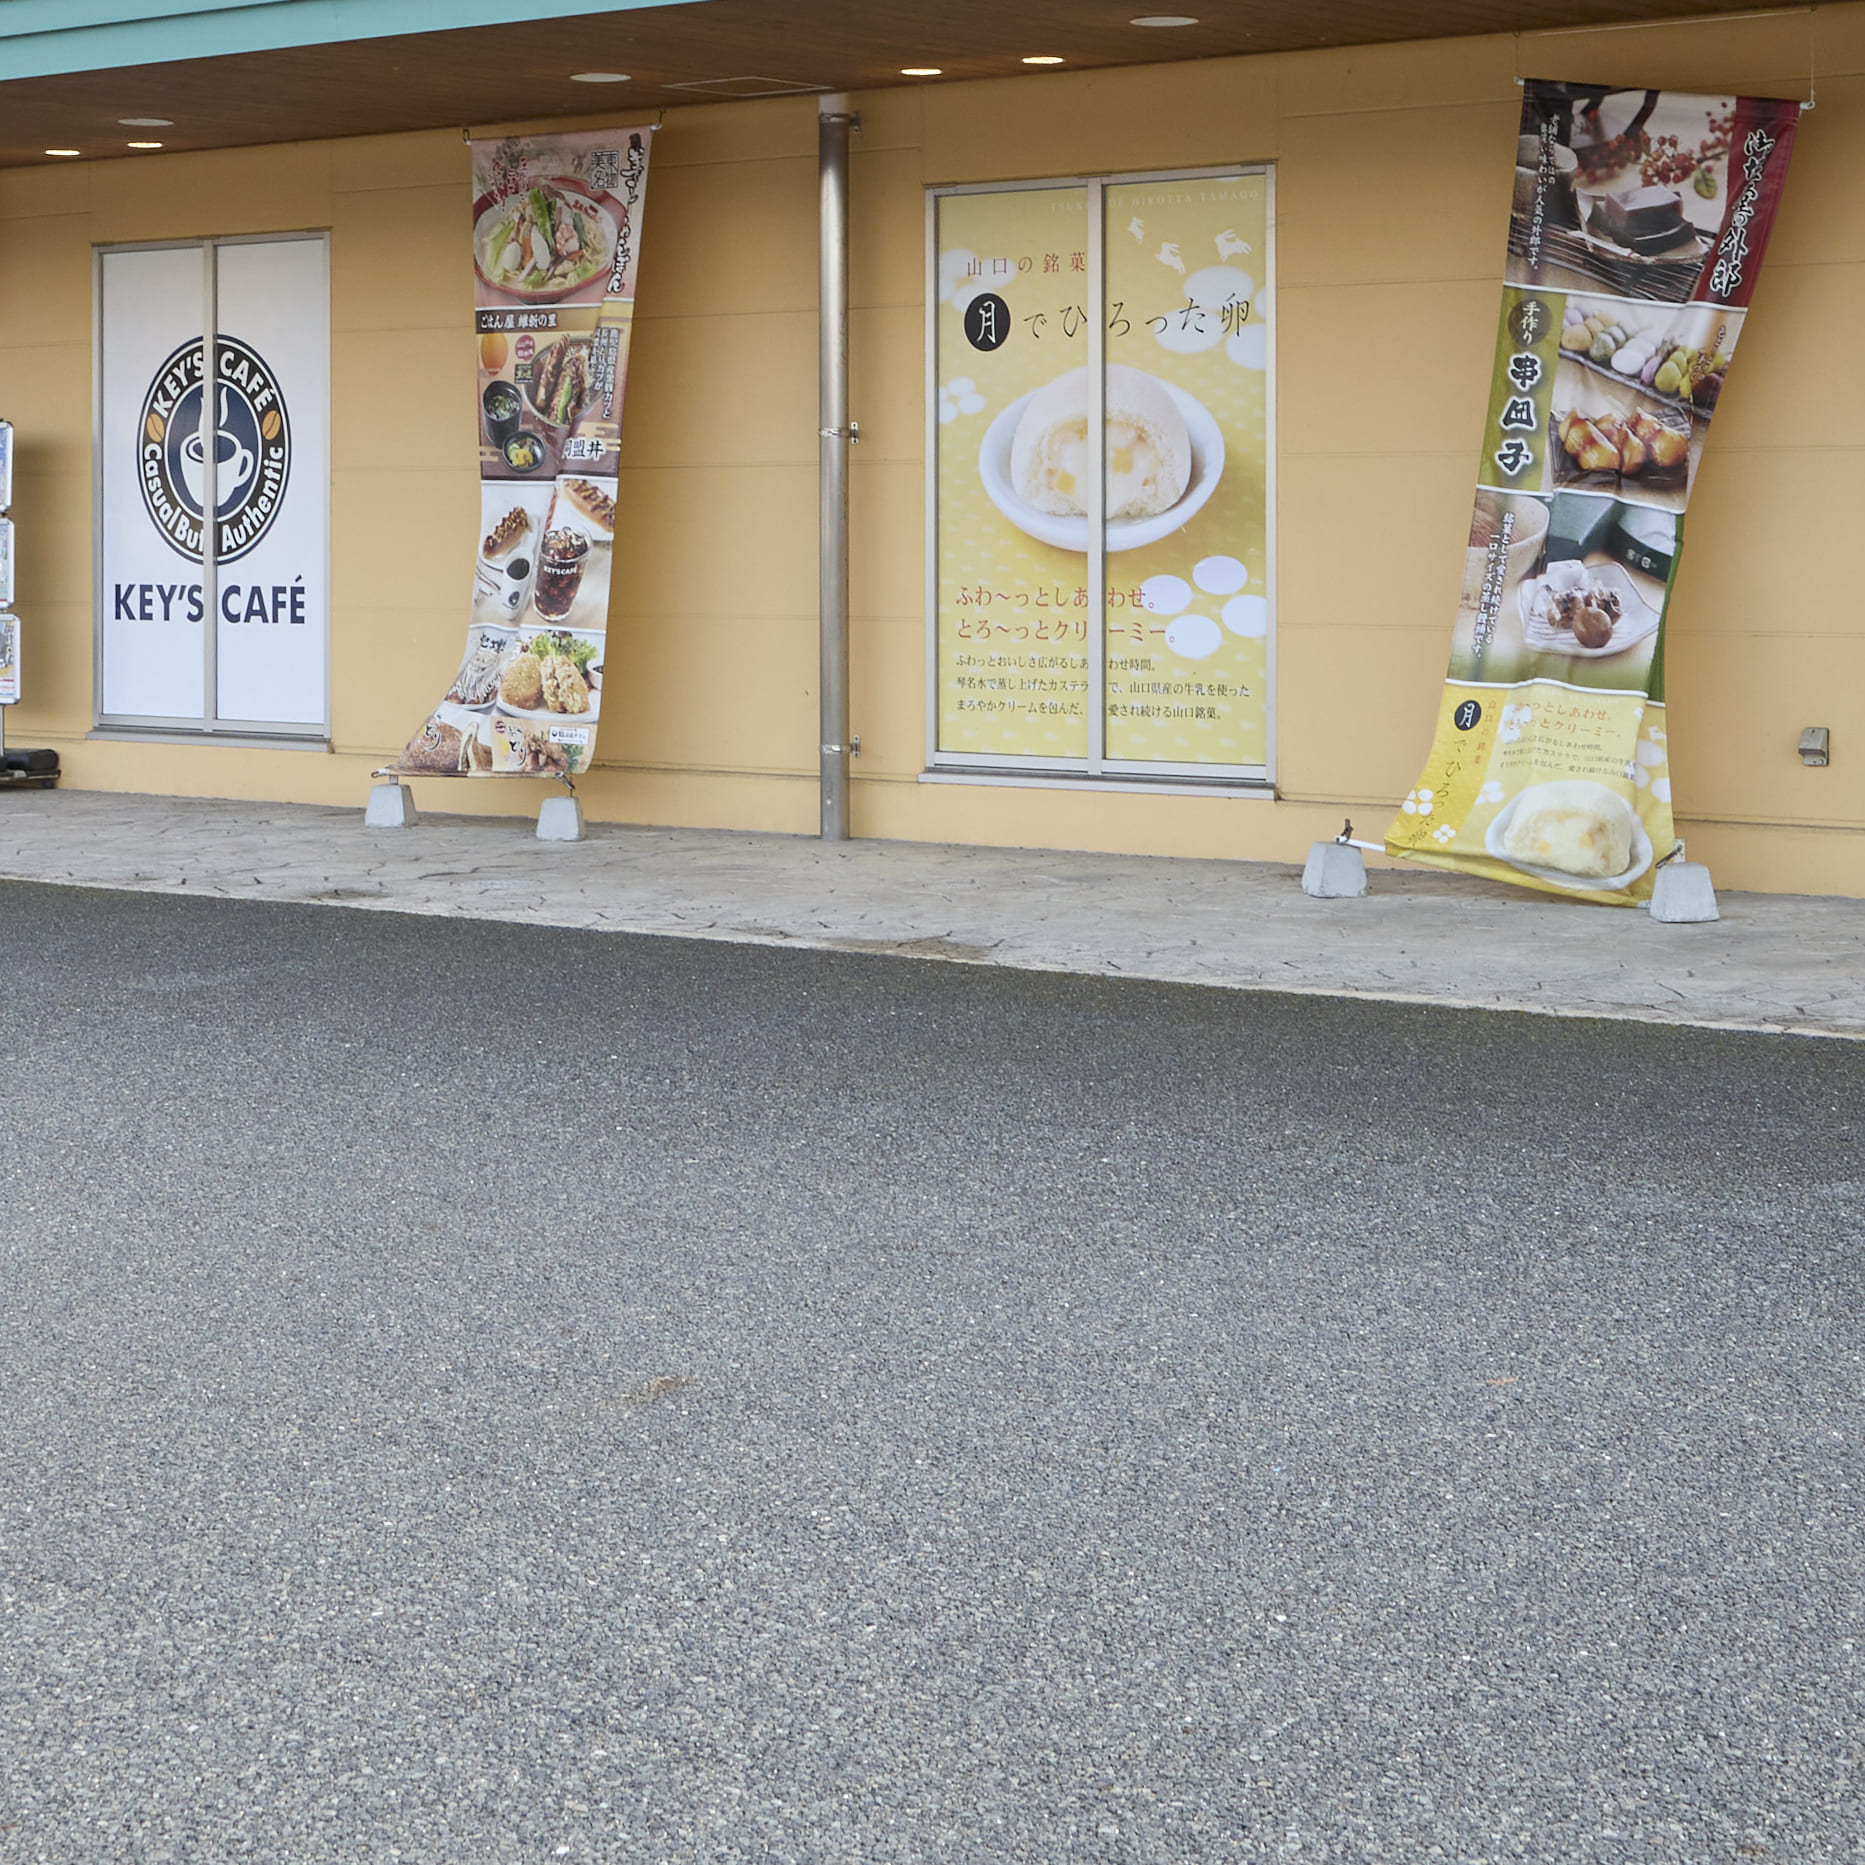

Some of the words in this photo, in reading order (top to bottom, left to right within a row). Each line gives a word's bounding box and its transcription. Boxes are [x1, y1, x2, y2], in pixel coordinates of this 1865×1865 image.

[1051, 200, 1088, 213] TSUK
[967, 251, 1086, 277] 山口の銘菓
[976, 293, 1250, 344] 月でひろった卵
[1521, 301, 1541, 344] 手作り
[152, 350, 203, 419] KEY'S
[220, 349, 275, 412] CAFÉ
[1495, 354, 1541, 475] 串団子
[144, 443, 181, 532] Casual
[221, 447, 284, 553] Authentic
[115, 583, 203, 622] KEY'S
[222, 574, 305, 624] CAFÉ
